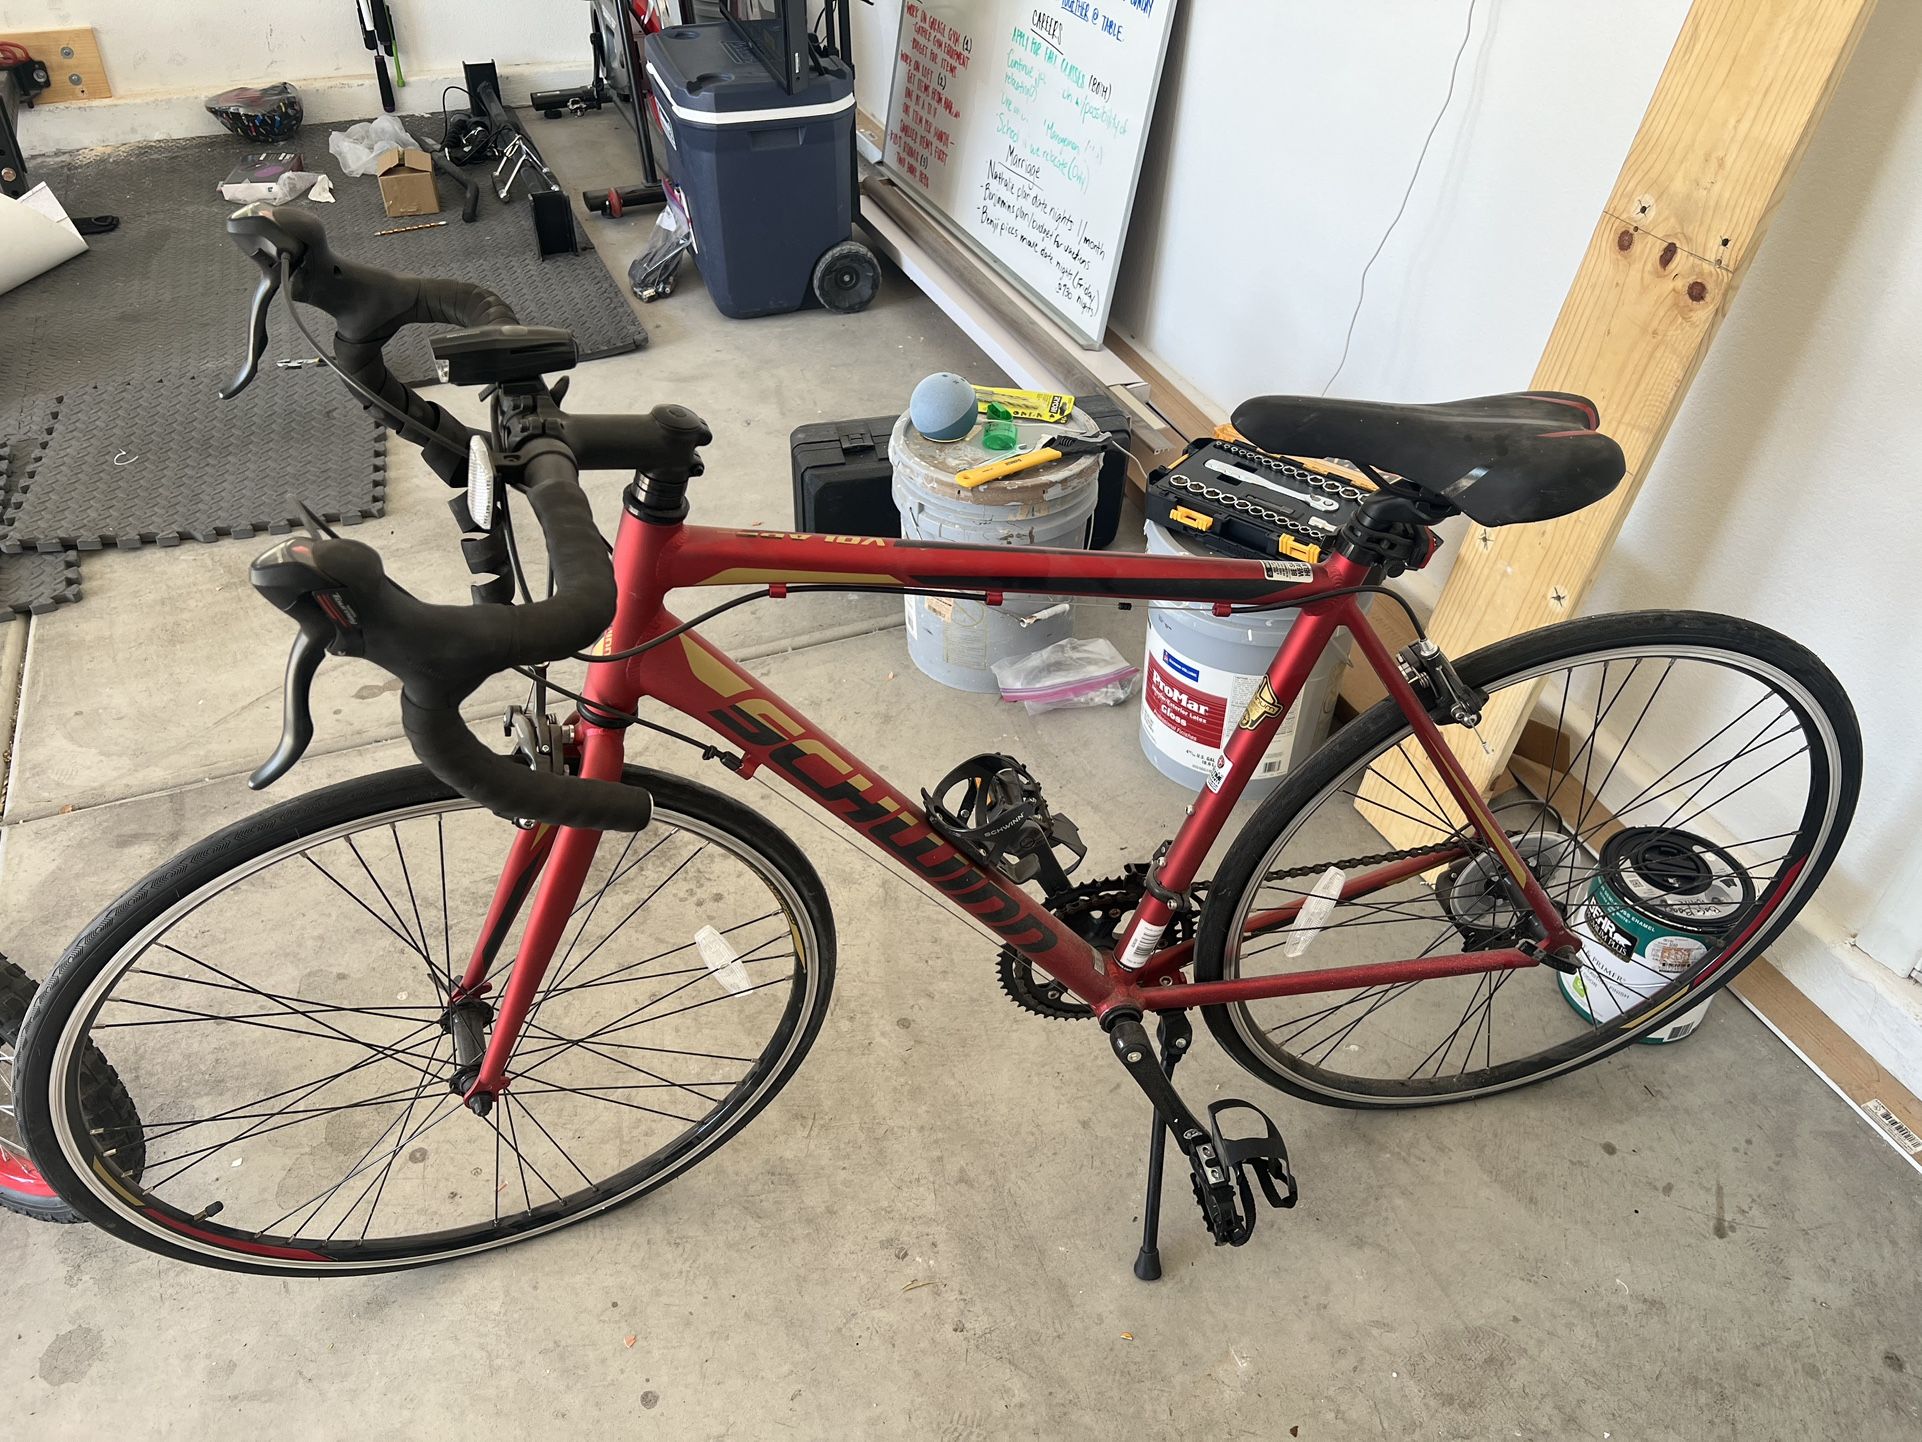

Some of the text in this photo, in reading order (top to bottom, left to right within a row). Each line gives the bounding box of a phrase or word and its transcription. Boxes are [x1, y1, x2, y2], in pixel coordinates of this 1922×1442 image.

[1031, 9, 1063, 46] CAREERS
[1091, 7, 1099, 25] @
[1006, 144, 1041, 190] Marriage
[1050, 396, 1061, 413] RYOBI
[1153, 668, 1209, 716] ProMar
[1161, 704, 1187, 727] Gloss
[1189, 713, 1207, 724] Latex
[707, 697, 1059, 955] SCHWINN
[984, 812, 1024, 838] SCHWINN
[1631, 916, 1656, 933] ENAMEL
[1608, 938, 1628, 957] PLUS
